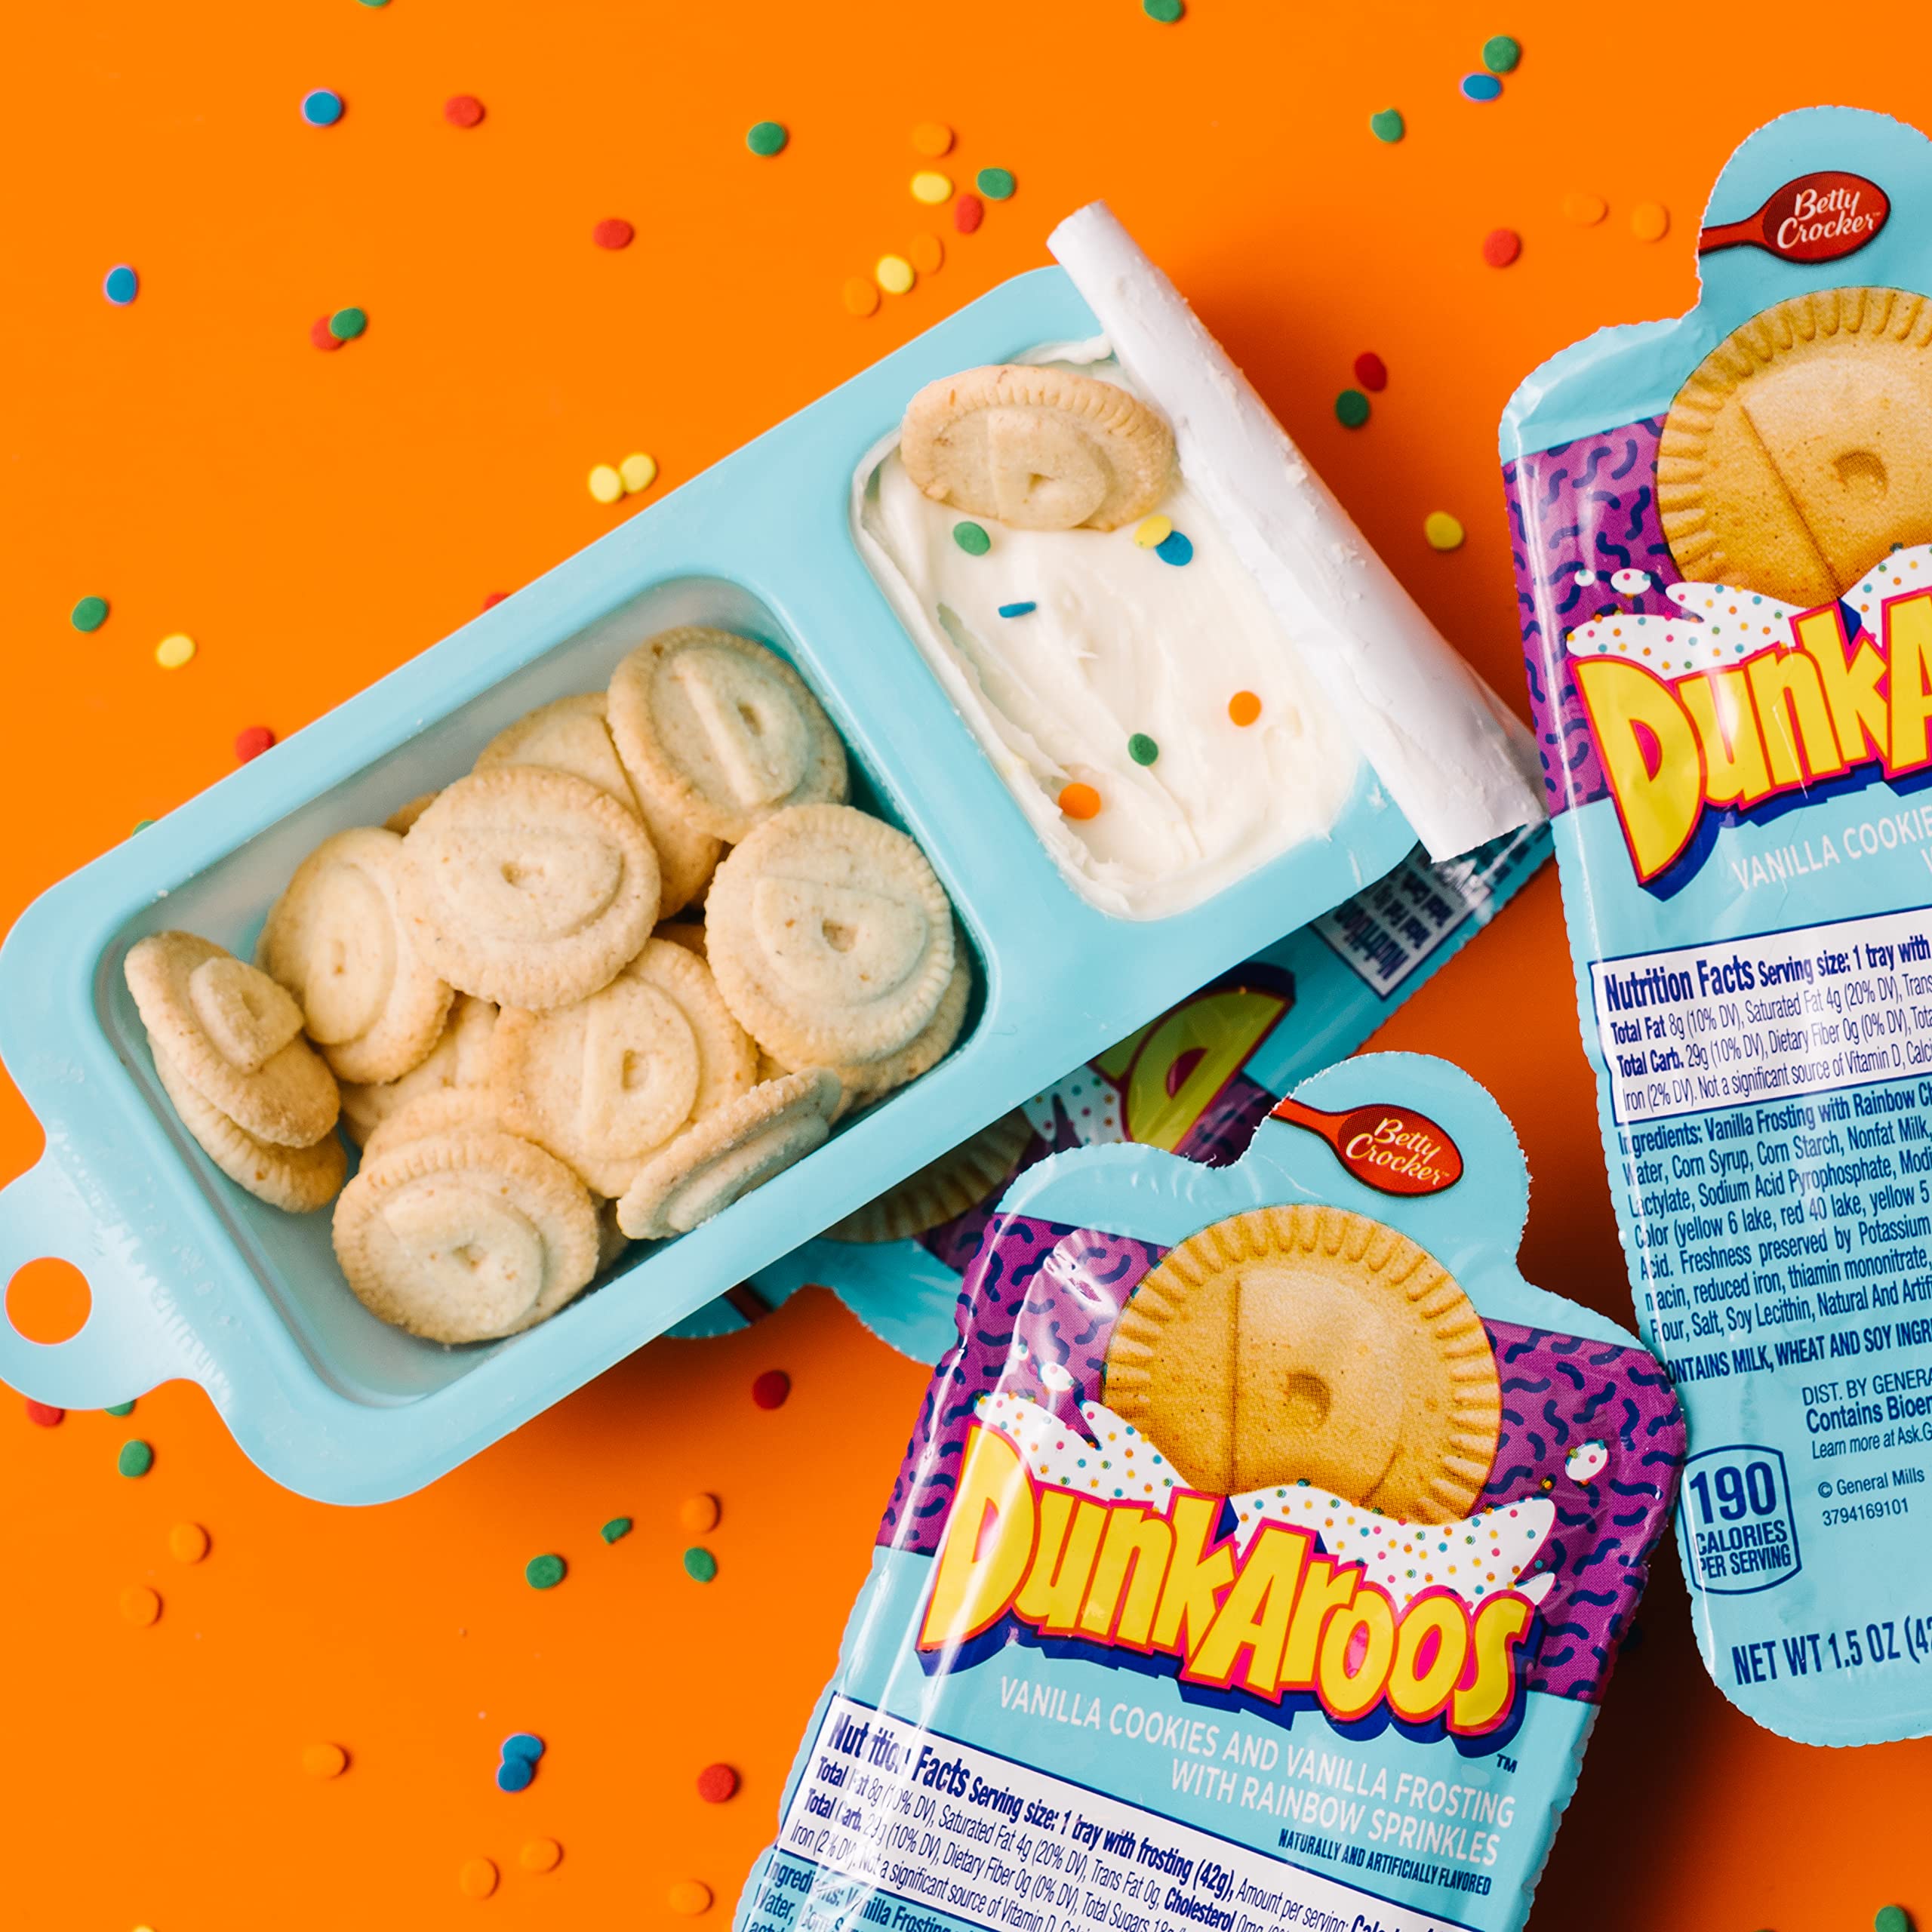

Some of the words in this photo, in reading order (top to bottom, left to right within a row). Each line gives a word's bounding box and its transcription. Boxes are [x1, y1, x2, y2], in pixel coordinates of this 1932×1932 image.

[1777, 211, 1874, 248] Crocker
[1795, 188, 1860, 220] Betty
[1731, 835, 1841, 890] VANILLA
[1604, 966, 1694, 1011] Nutrition
[1697, 955, 1755, 997] Facts
[1758, 955, 1814, 987] Serving
[1817, 949, 1850, 977] size:
[1852, 944, 1862, 970] 1
[1865, 943, 1894, 971] tray
[1897, 934, 1931, 963] with
[1610, 1018, 1642, 1044] Total
[1644, 1014, 1667, 1039] Fat
[1668, 1013, 1685, 1040] 8g
[1686, 1007, 1717, 1038] (10%
[1718, 1002, 1745, 1031] DV),
[1745, 992, 1801, 1023] Saturated
[1803, 989, 1824, 1014] Fat
[1826, 986, 1842, 1014] 4g
[1844, 980, 1875, 1011] (20%
[1877, 975, 1903, 1004] DV),
[1616, 1051, 1647, 1078] Total
[1650, 1046, 1684, 1072] Carb.
[1685, 1043, 1709, 1070] 29g
[1710, 1036, 1742, 1069] (10%
[1742, 1032, 1768, 1060] DV),
[1768, 1028, 1808, 1054] Dietary
[1810, 1022, 1840, 1046] Fiber
[1842, 1017, 1860, 1045] 0g
[1860, 1012, 1885, 1043] (0%
[1886, 1008, 1912, 1037] DV),
[1623, 1088, 1646, 1111] Iron
[1647, 1081, 1671, 1112] (2%
[1672, 1078, 1697, 1106] DV).
[1697, 1075, 1720, 1099] Not
[1721, 1077, 1730, 1096] a
[1731, 1063, 1789, 1097] significant
[1791, 1060, 1830, 1084] source
[1832, 1051, 1844, 1077] of
[1844, 1046, 1890, 1074] Vitamin
[1890, 1043, 1906, 1070] D,
[1374, 1118, 1441, 1164] Betty
[1704, 1112, 1754, 1142] Vanilla
[1755, 1103, 1815, 1134] Frosting
[1817, 1096, 1851, 1123] with
[1852, 1088, 1915, 1117] Rainbow
[1346, 1133, 1441, 1186] Crocker
[1671, 1154, 1706, 1180] Corn
[1708, 1148, 1754, 1178] Syrup,
[1756, 1140, 1790, 1166] Corn
[1792, 1130, 1844, 1159] Starch,
[1847, 1121, 1896, 1150] Nonfat
[1697, 1179, 1751, 1208] Sodium
[1755, 1170, 1786, 1198] Acid
[1787, 1155, 1897, 1196] Pyrophosphate,
[1673, 1215, 1723, 1248] (yellow
[1727, 1210, 1738, 1235] 6
[1741, 1206, 1777, 1232] lake,
[1780, 1199, 1804, 1226] red
[1809, 1196, 1827, 1221] 40
[1829, 1192, 1866, 1218] lake,
[1869, 1184, 1915, 1217] yellow
[1918, 1179, 1930, 1204] 5
[1640, 1252, 1674, 1281] Acid.
[1679, 1244, 1752, 1274] Freshness
[1758, 1228, 1828, 1267] preserved
[1833, 1225, 1851, 1254] by
[1858, 1214, 1931, 1246] Potassium
[1690, 1309, 1724, 1337] Salt,
[1725, 1306, 1752, 1334] Soy
[1754, 1296, 1816, 1327] Lecithin,
[1816, 1285, 1869, 1316] Natural
[1872, 1280, 1900, 1309] And
[1693, 1272, 1751, 1304] reduced
[1752, 1270, 1786, 1295] iron,
[1787, 1258, 1841, 1289] thiamin
[1731, 1344, 1774, 1374] MILK,
[1774, 1334, 1825, 1366] WHEAT
[1829, 1330, 1861, 1358] AND
[1863, 1324, 1891, 1352] SOY
[1801, 1382, 1842, 1406] DIST.
[1845, 1377, 1867, 1399] BY
[1805, 1401, 1884, 1434] Contains
[1811, 1440, 1847, 1460] Learn
[1849, 1434, 1881, 1453] more
[1883, 1429, 1895, 1448] at
[1689, 1461, 1777, 1524] 190
[1836, 1472, 1889, 1496] General
[1891, 1467, 1925, 1486] Mills
[1695, 1519, 1787, 1556] CALORIES
[1822, 1497, 1908, 1526] 3794169101
[916, 1420, 1539, 1739] DunkAroos
[1729, 1543, 1792, 1575] SERVING
[1731, 1640, 1777, 1685] NET
[1782, 1633, 1822, 1676] WT
[1827, 1629, 1863, 1669] 1.5
[1866, 1621, 1901, 1663] OZ
[1001, 1676, 1100, 1729] VANILLA
[1109, 1703, 1220, 1757] COOKIES
[1223, 1731, 1278, 1770] AND
[1287, 1745, 1386, 1798] VANILLA
[1394, 1773, 1515, 1828] FROSTING
[911, 1745, 971, 1798] Facts
[968, 1776, 1024, 1823] Serving
[1023, 1798, 1060, 1831] size:
[1060, 1810, 1072, 1835] 1
[1071, 1814, 1103, 1851] tray
[1103, 1829, 1136, 1860] with
[1136, 1837, 1194, 1886] frosting
[1192, 1859, 1235, 1902] (42g),
[1235, 1878, 1283, 1914] Amount
[1278, 1899, 1304, 1921] per
[1172, 1758, 1237, 1803] WITH
[1241, 1777, 1364, 1833] RAINBOW
[1367, 1808, 1500, 1866] SPRINKLES
[804, 1788, 837, 1819] Total
[885, 1822, 919, 1853] (10%
[918, 1832, 941, 1866] DV),
[943, 1841, 986, 1881] Dietary
[983, 1857, 1016, 1886] Fiber
[1014, 1868, 1032, 1899] 0g
[1030, 1874, 1057, 1903] (0%
[1056, 1882, 1079, 1915] DV),
[1081, 1891, 1112, 1922] Total
[816, 1756, 849, 1787] Total
[867, 1777, 883, 1807] 8g
[912, 1795, 936, 1828] DV),
[938, 1804, 996, 1844] Saturated
[994, 1824, 1017, 1851] Fat
[1016, 1832, 1032, 1863] 4g
[1032, 1839, 1066, 1869] (20%
[1064, 1850, 1088, 1883] DV),
[1091, 1859, 1122, 1890] Trans
[1121, 1871, 1144, 1899] Fat
[1143, 1879, 1161, 1910] 0g,
[1164, 1887, 1237, 1932] Cholesterol
[1278, 1828, 1341, 1860] NATURALLY
[1340, 1844, 1366, 1867] AND
[1365, 1850, 1438, 1884] ARTIFICIALLY
[1437, 1867, 1492, 1896] FLAVORED
[789, 1819, 815, 1847] Iron
[880, 1860, 890, 1879] a
[889, 1860, 949, 1900] significant
[947, 1884, 987, 1913] source
[986, 1896, 1004, 1918] of
[1001, 1897, 1044, 1932] Vitamin
